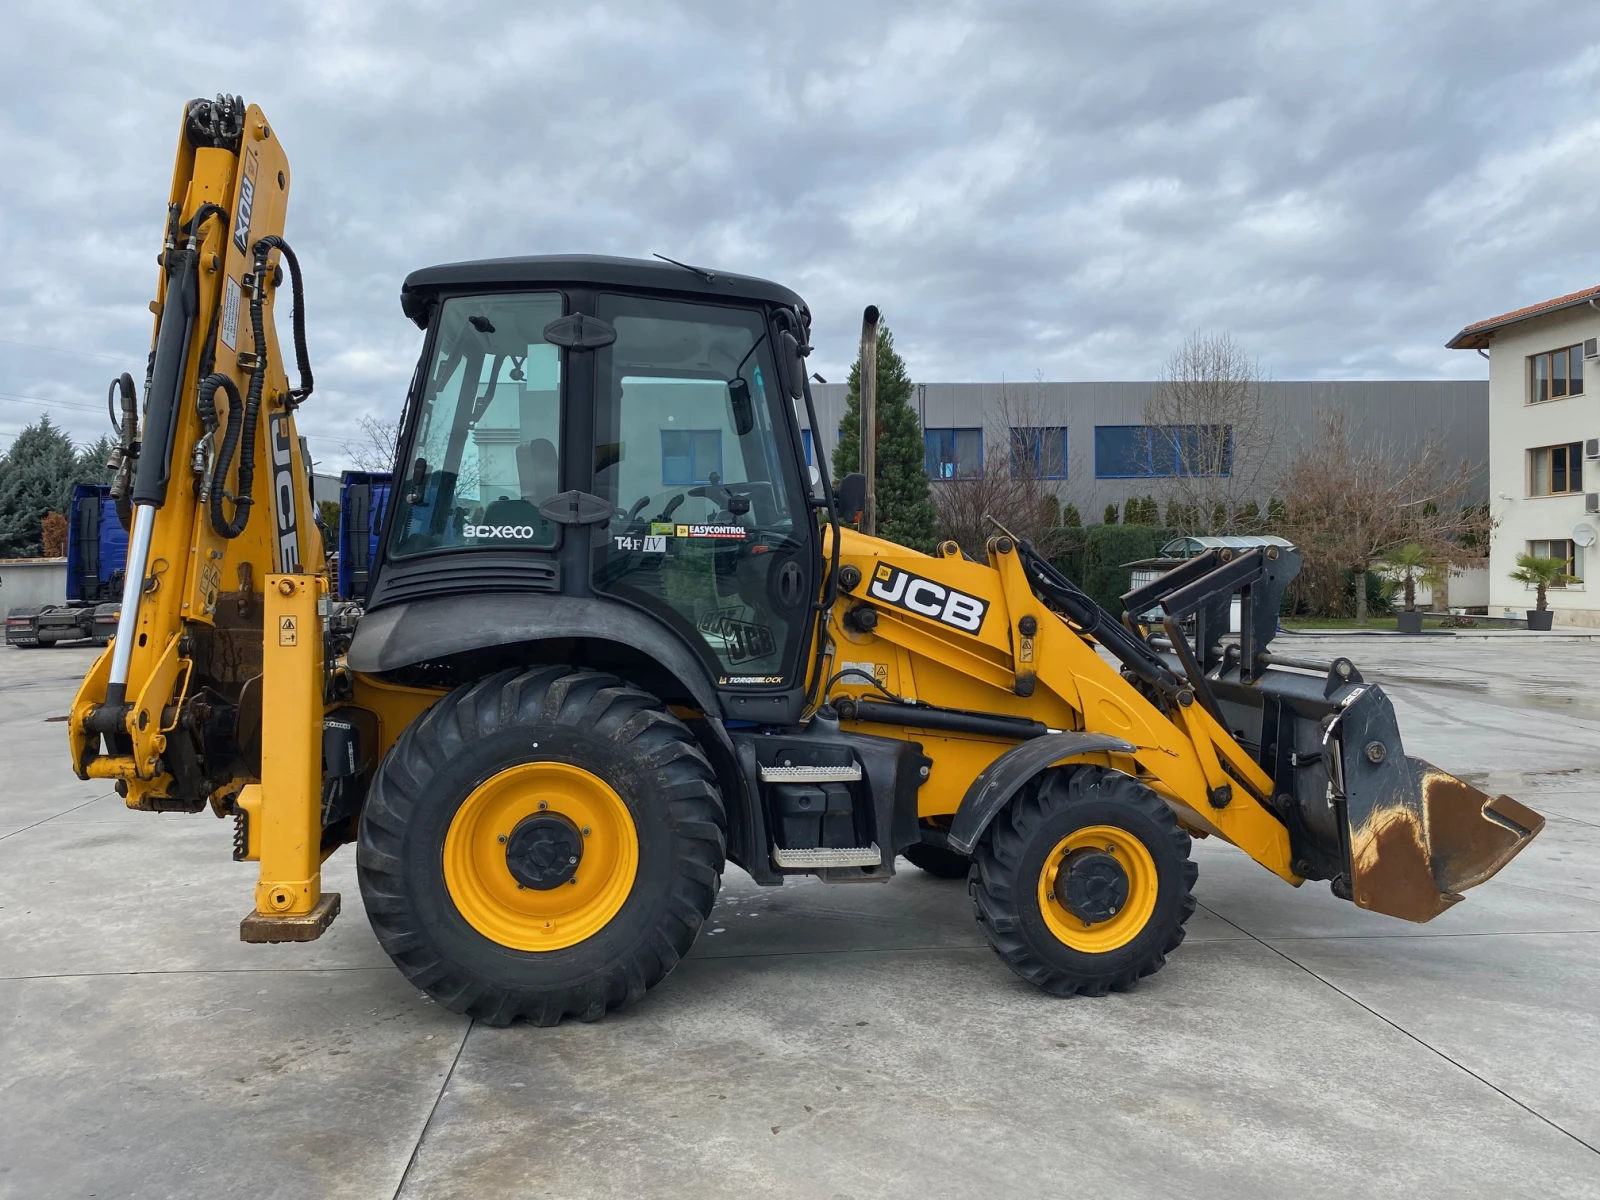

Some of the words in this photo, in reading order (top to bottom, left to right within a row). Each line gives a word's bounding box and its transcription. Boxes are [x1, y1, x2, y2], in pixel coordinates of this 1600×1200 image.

[689, 525, 746, 534] EASYCONTROL
[872, 572, 984, 630] JCB
[730, 623, 773, 660] JCB
[729, 676, 784, 684] TORQUELOCK
